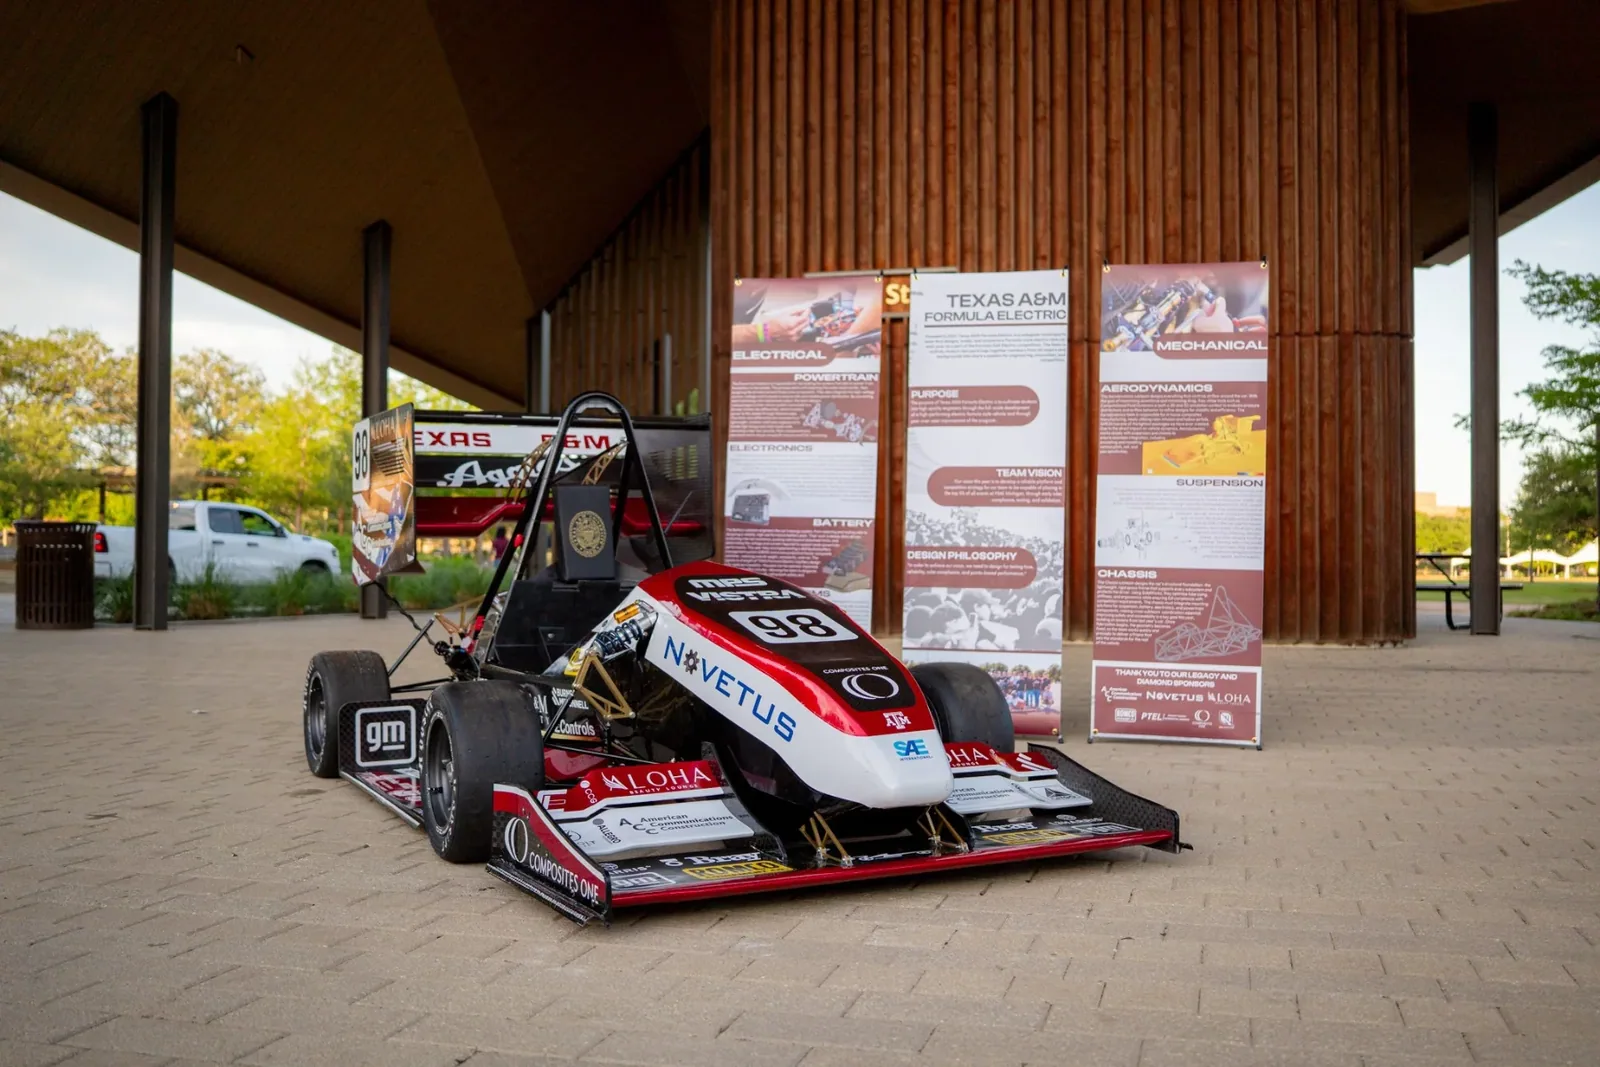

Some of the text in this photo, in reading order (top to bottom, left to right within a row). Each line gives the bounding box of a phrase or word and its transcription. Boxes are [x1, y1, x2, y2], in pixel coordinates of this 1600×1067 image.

[946, 292, 1066, 308] TEXAS A&M
[924, 309, 1067, 322] FORMULA ELECTRIC
[1156, 340, 1268, 351] MECHANICAL
[732, 350, 827, 360] ELECTRICAL
[794, 373, 878, 382] POWERTRAIN
[910, 389, 960, 399] PURPOSE
[1100, 384, 1213, 393] AERODYNAMICS
[413, 431, 491, 447] EXAS
[729, 444, 812, 453] ELECTRONICS
[354, 430, 368, 480] 98
[996, 468, 1062, 478] TEAM VISION
[1176, 478, 1264, 487] SUSPENSION
[813, 518, 873, 528] BATTERY
[907, 551, 1017, 561] DESIGN PHILOSOPHY
[1097, 569, 1157, 579] CHASSIS
[686, 589, 807, 602] VISTRA
[747, 614, 837, 638] 98
[823, 666, 871, 674] COMPOSITES
[1115, 668, 1238, 681] THANK YOU TO OUR LEGACY AND
[1136, 678, 1215, 688] DIAMOND SPONSORS
[1146, 691, 1204, 703] NOVETUS
[1141, 711, 1162, 721] PTEL
[559, 718, 596, 736] Controls
[366, 720, 405, 752] gm
[893, 738, 929, 757] SAE
[601, 767, 712, 791] ALOHA
[629, 783, 698, 795] BEAUTY LOUNGE
[585, 788, 598, 804] CCG
[640, 813, 688, 823] American
[650, 815, 734, 828] Communications
[660, 821, 726, 832] Construction
[597, 824, 621, 844] ALLEGRO
[684, 852, 762, 865] Bray
[529, 851, 599, 899] COMPOSITES ONE
